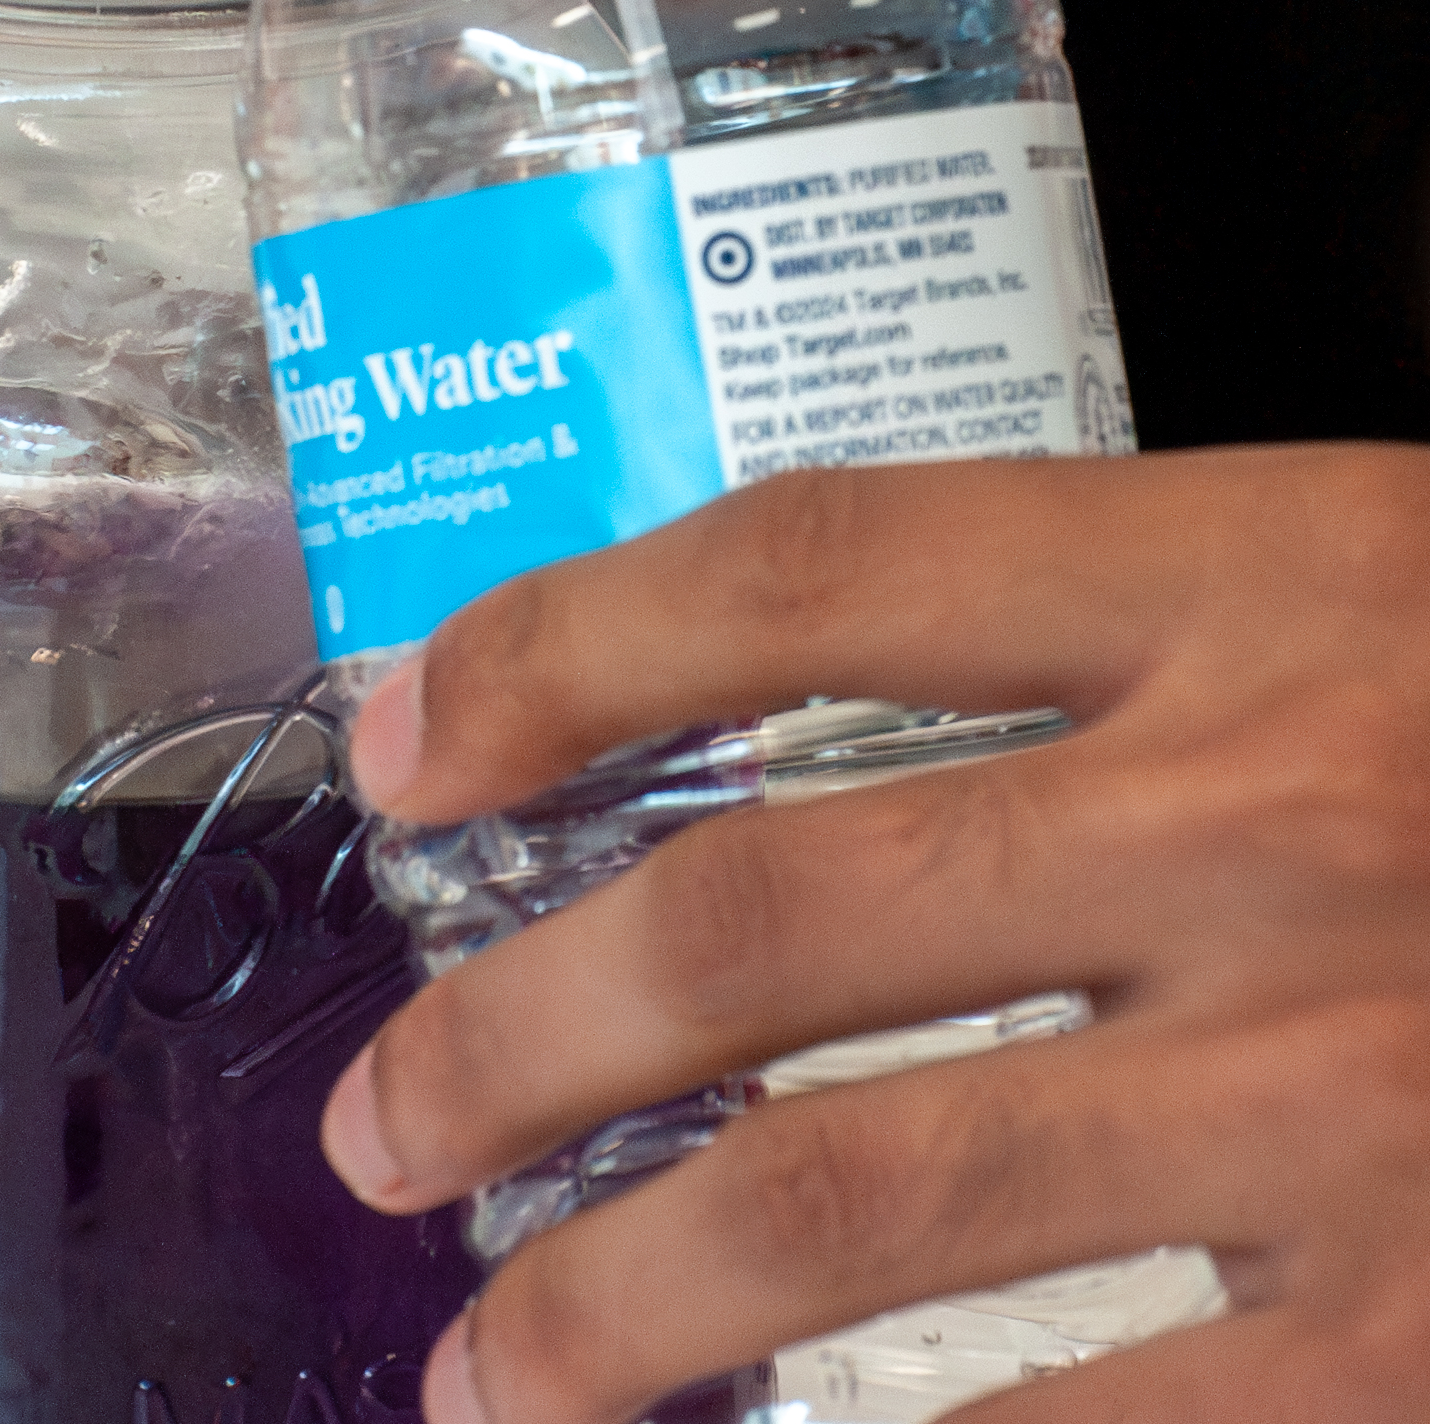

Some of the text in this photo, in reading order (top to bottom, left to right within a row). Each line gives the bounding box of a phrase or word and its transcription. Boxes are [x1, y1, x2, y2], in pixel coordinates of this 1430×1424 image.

[691, 173, 841, 218] INGREDIENTS:
[848, 158, 928, 192] PURIFIED
[815, 213, 838, 240] BY
[841, 203, 905, 237] TARGET
[711, 310, 747, 335] TM
[852, 284, 918, 315] Target
[717, 323, 912, 372] Shop Target.com
[362, 329, 574, 422] Water
[725, 377, 783, 403] Keep
[788, 362, 882, 397] package
[886, 355, 914, 377] for
[732, 418, 777, 446] FOR
[784, 410, 798, 435] A
[803, 397, 887, 433] REPORT
[893, 393, 928, 420] ON
[934, 381, 994, 412] WATER
[411, 436, 547, 485] Filtration
[738, 449, 788, 479] AND
[957, 408, 1043, 445] CONTACT
[336, 482, 512, 539] Technologies
